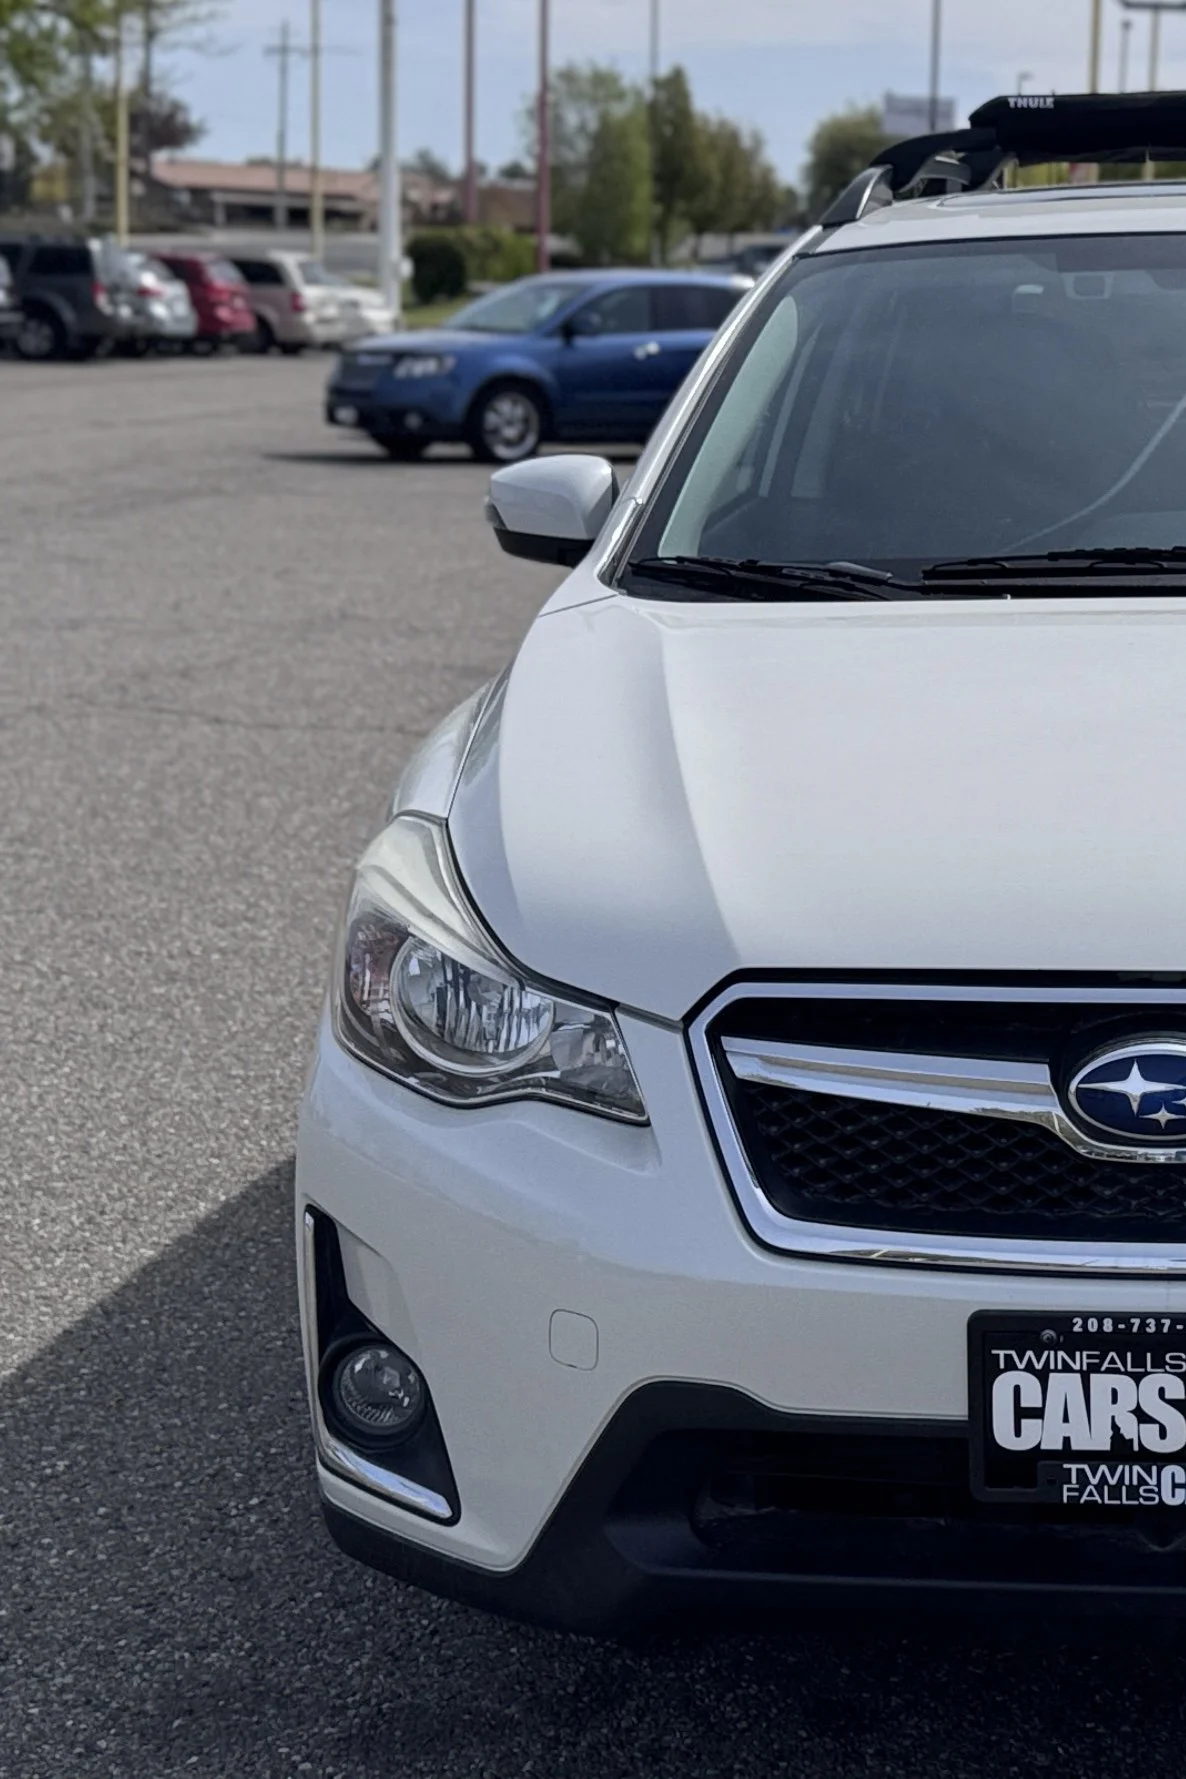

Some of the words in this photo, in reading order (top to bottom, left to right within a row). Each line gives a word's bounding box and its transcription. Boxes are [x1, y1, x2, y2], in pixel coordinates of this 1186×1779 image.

[1008, 97, 1055, 109] THULE
[1063, 1464, 1158, 1486] TWIN
[1062, 1485, 1160, 1505] FALLS
